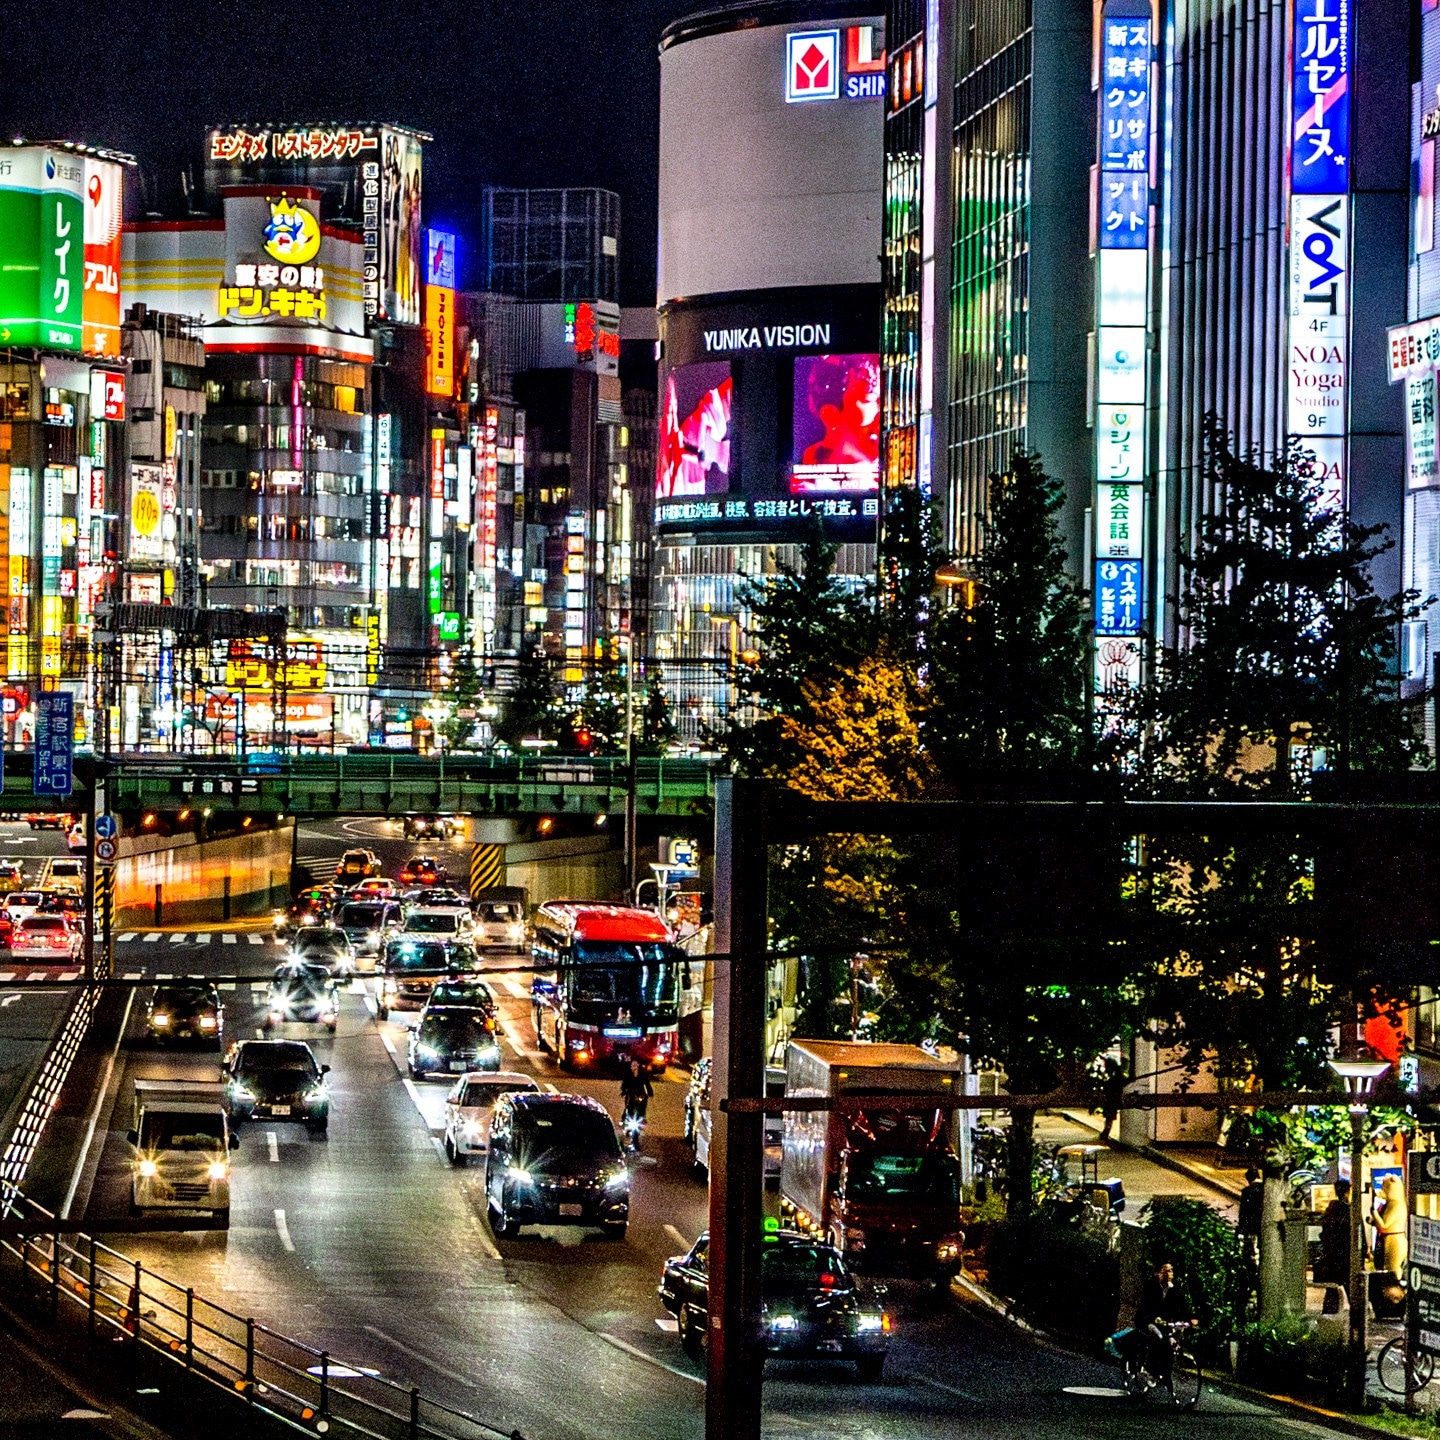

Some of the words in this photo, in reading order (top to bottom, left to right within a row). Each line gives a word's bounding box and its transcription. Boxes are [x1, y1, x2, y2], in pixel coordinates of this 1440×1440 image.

[1105, 25, 1126, 231] 新宿クリニック
[1126, 26, 1148, 232] スキンサポート
[211, 133, 267, 161] エンタメ
[274, 130, 378, 160] レストランタワー
[56, 163, 82, 184] 新生銀行
[54, 201, 71, 314] レイク
[1303, 199, 1346, 316] VOAT
[84, 261, 118, 295] アコム
[436, 292, 447, 370] PROMISE
[703, 327, 762, 351] YUNIKA
[764, 323, 831, 347] VISION
[1308, 317, 1329, 332] 4F
[1292, 345, 1344, 364] NOA
[1291, 369, 1344, 393] Yoga
[1295, 396, 1340, 408] Studio
[1307, 413, 1328, 428] 9F
[1110, 431, 1131, 541] シェーン英会話
[1119, 562, 1138, 628] ベースボール
[50, 697, 68, 790] 新宿駅東口
